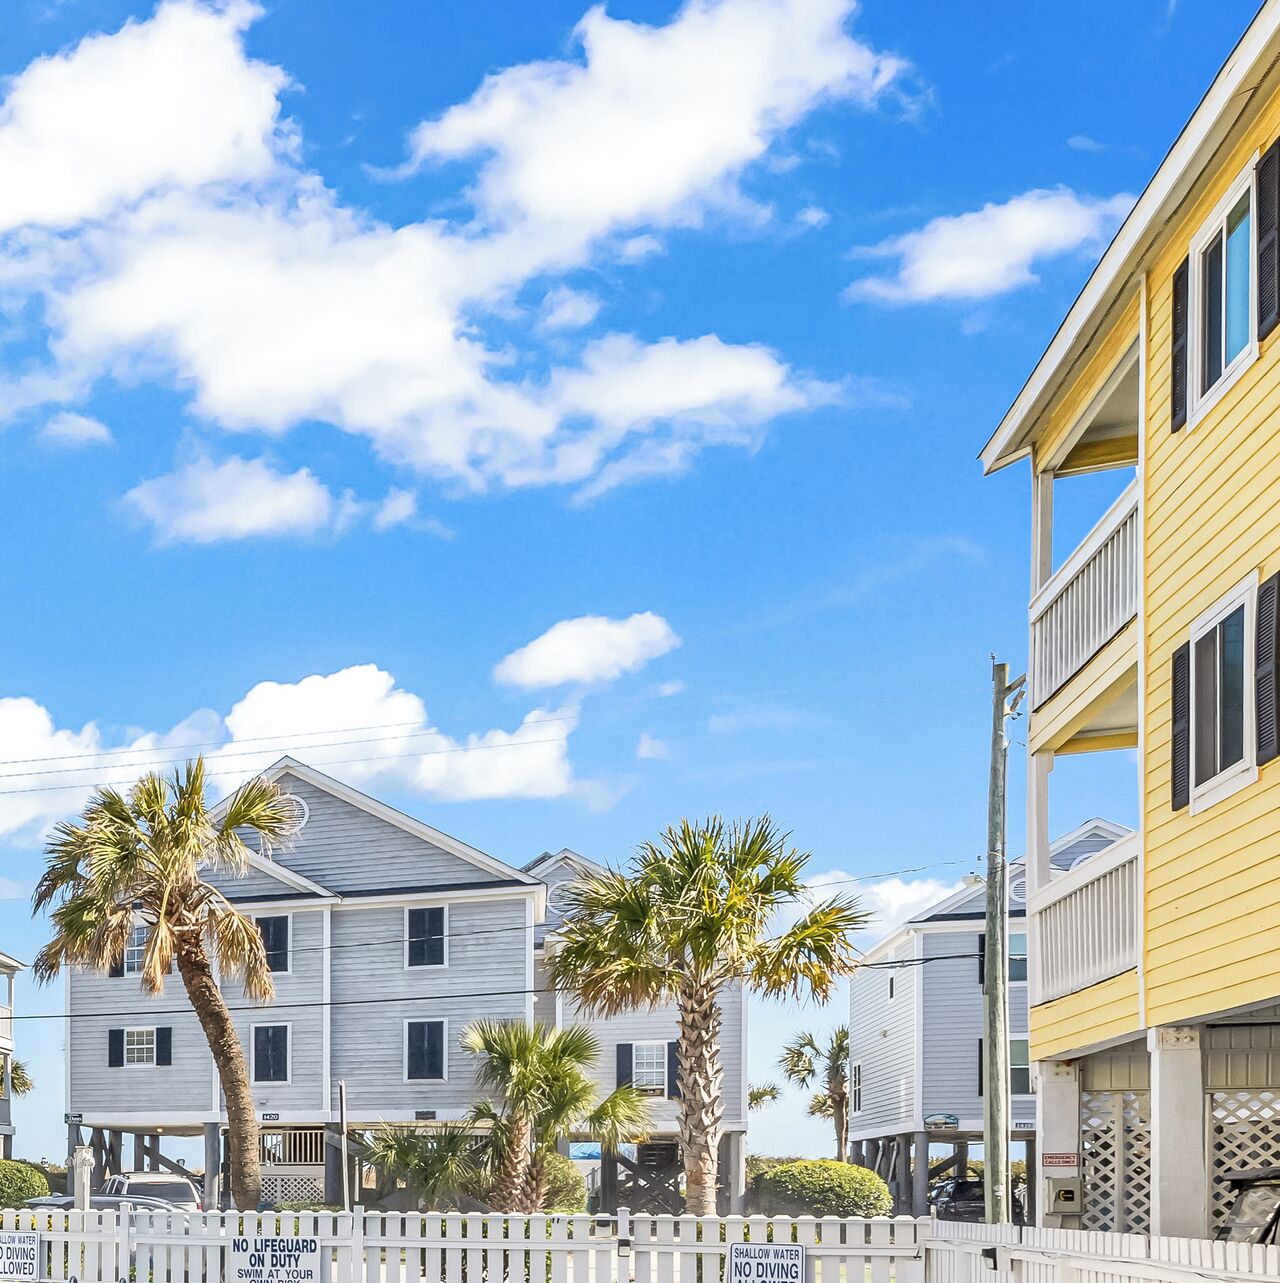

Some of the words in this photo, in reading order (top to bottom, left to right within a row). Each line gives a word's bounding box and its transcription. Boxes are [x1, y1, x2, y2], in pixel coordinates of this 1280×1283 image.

[17, 1235, 35, 1245] WATER
[232, 1238, 249, 1253] NO
[254, 1238, 317, 1253] LIFEGUARD
[6, 1246, 35, 1261] DIVING
[249, 1253, 265, 1268] ON
[270, 1253, 300, 1268] DUTY
[734, 1247, 770, 1259] SHALLOW
[773, 1248, 799, 1260] WATER
[237, 1268, 263, 1279] SWIM
[267, 1269, 281, 1279] AT
[285, 1269, 313, 1280] YOUR
[734, 1261, 751, 1278] NO
[756, 1262, 799, 1280] DIVING
